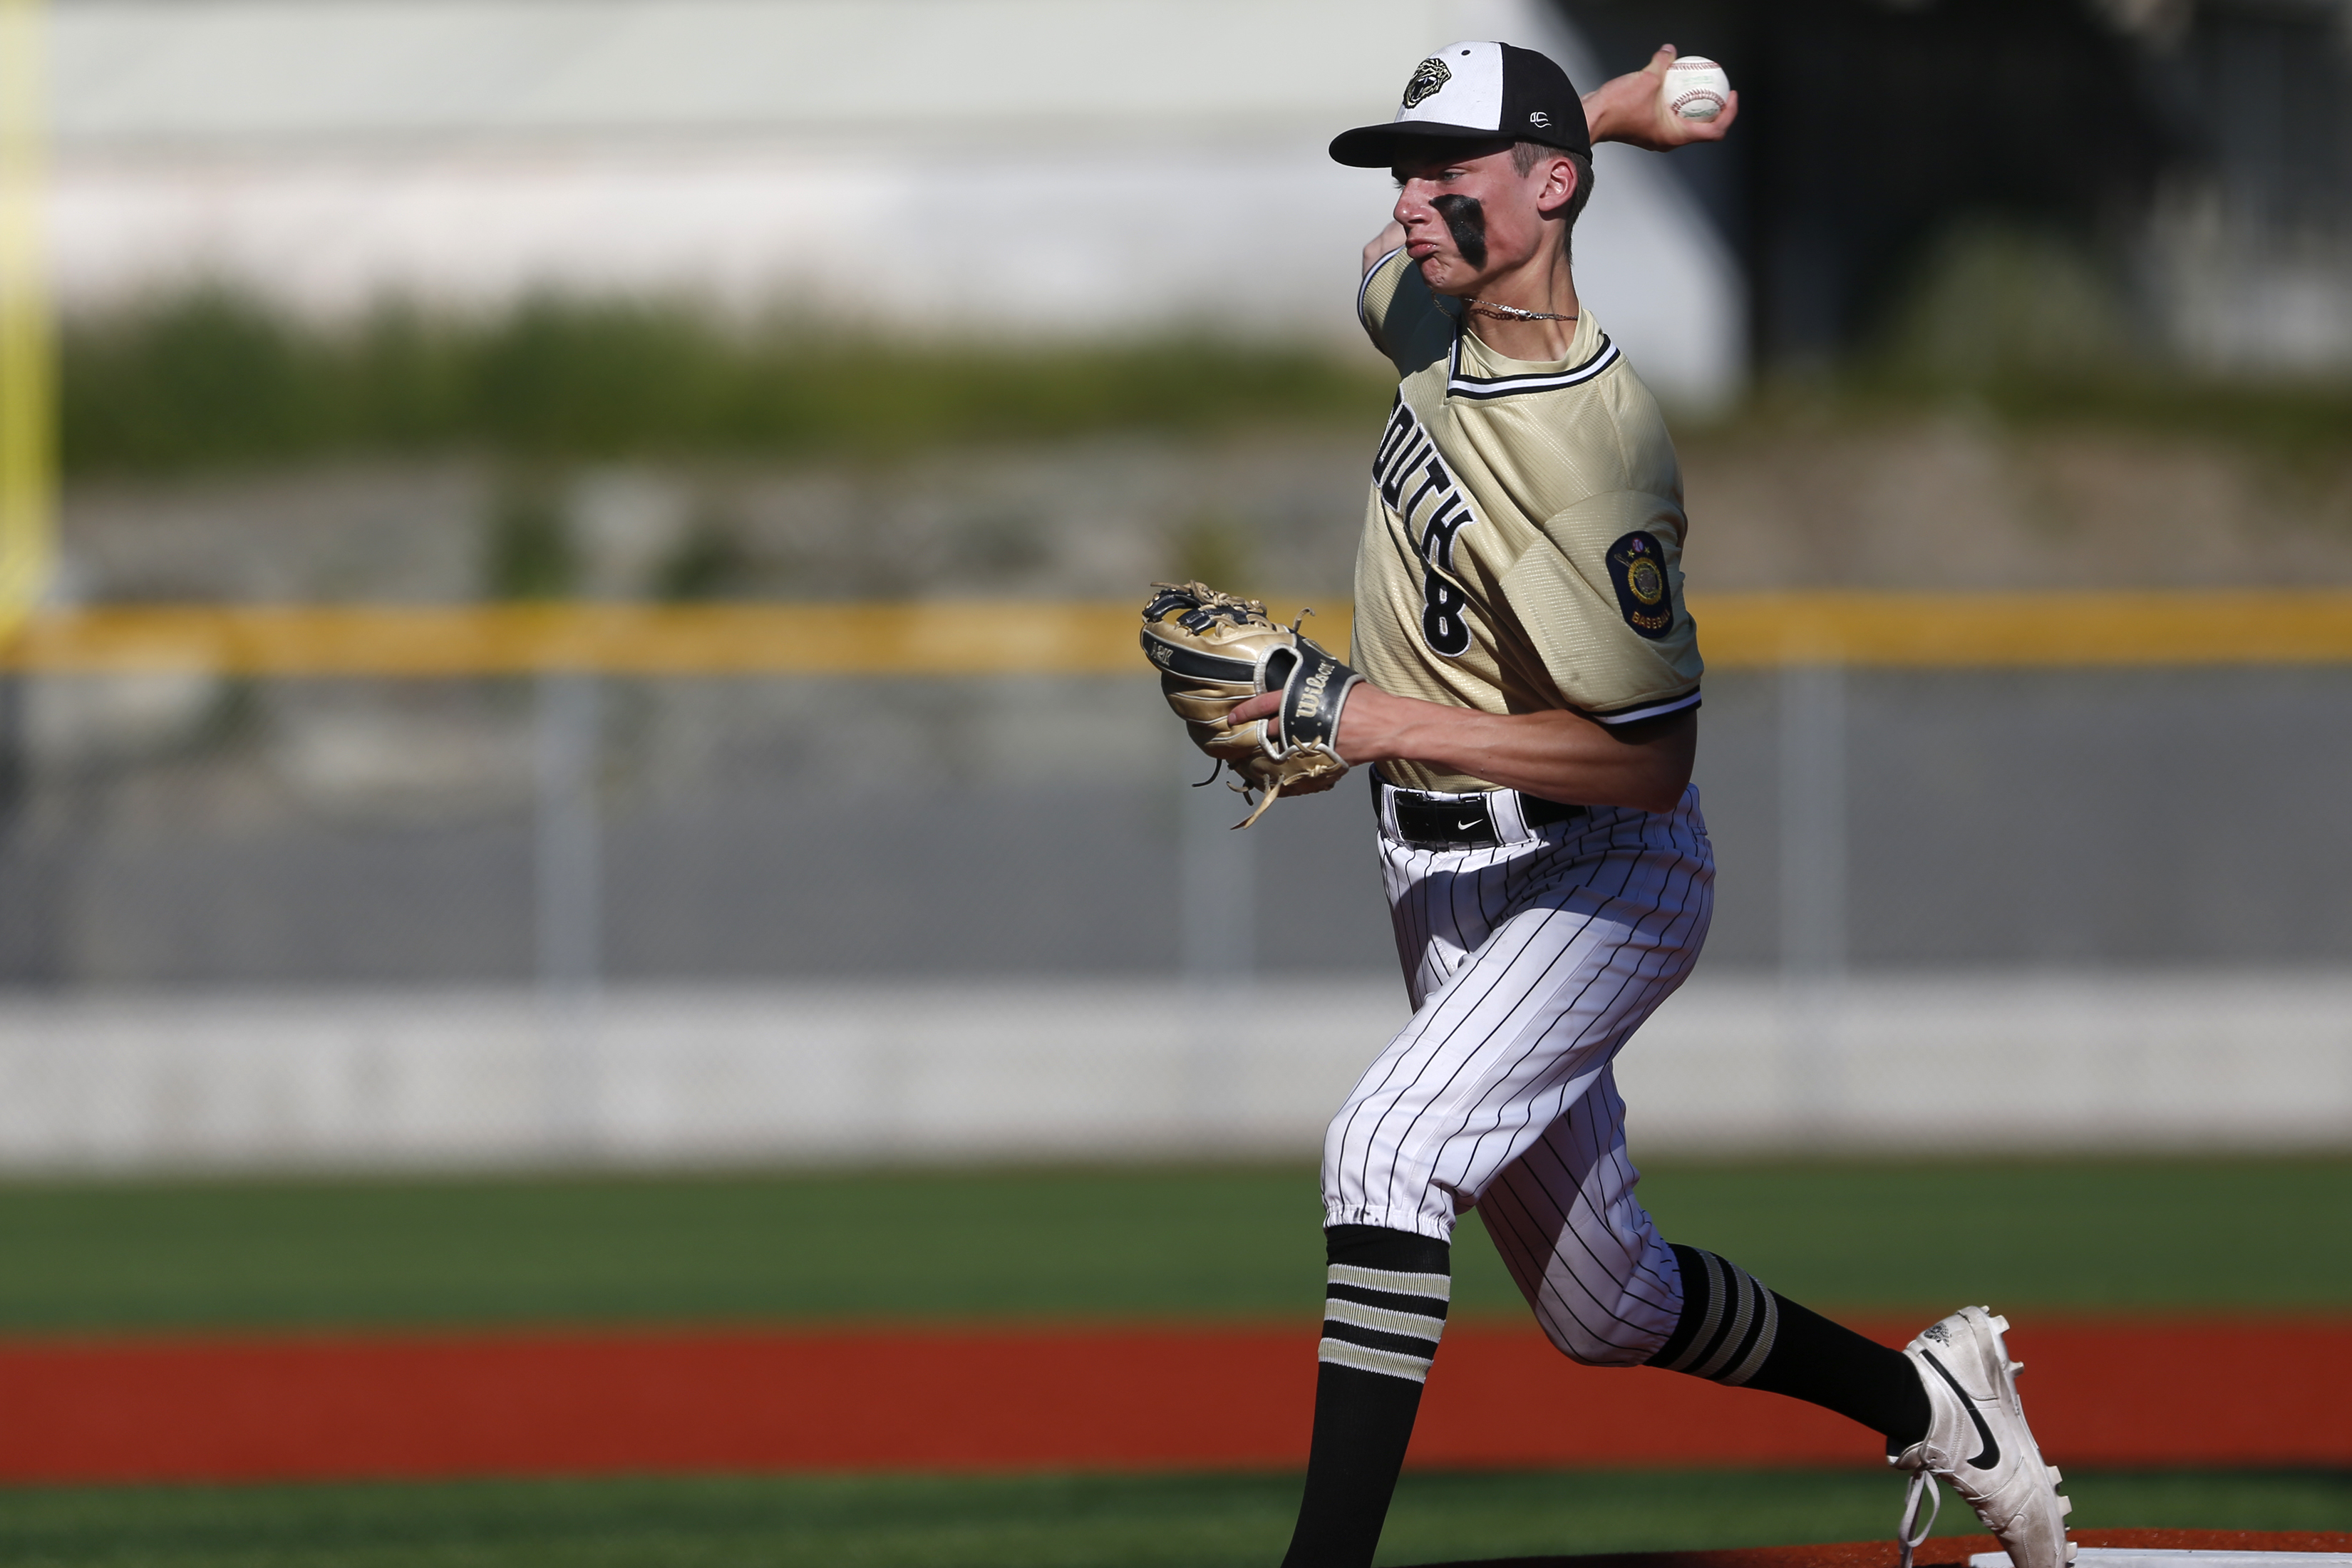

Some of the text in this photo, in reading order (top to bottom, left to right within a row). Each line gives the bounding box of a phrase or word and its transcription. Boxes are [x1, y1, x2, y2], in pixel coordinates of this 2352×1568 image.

[1372, 383, 1478, 574] OUTH
[1422, 567, 1472, 658] 8
[1295, 662, 1336, 718] Wilson
